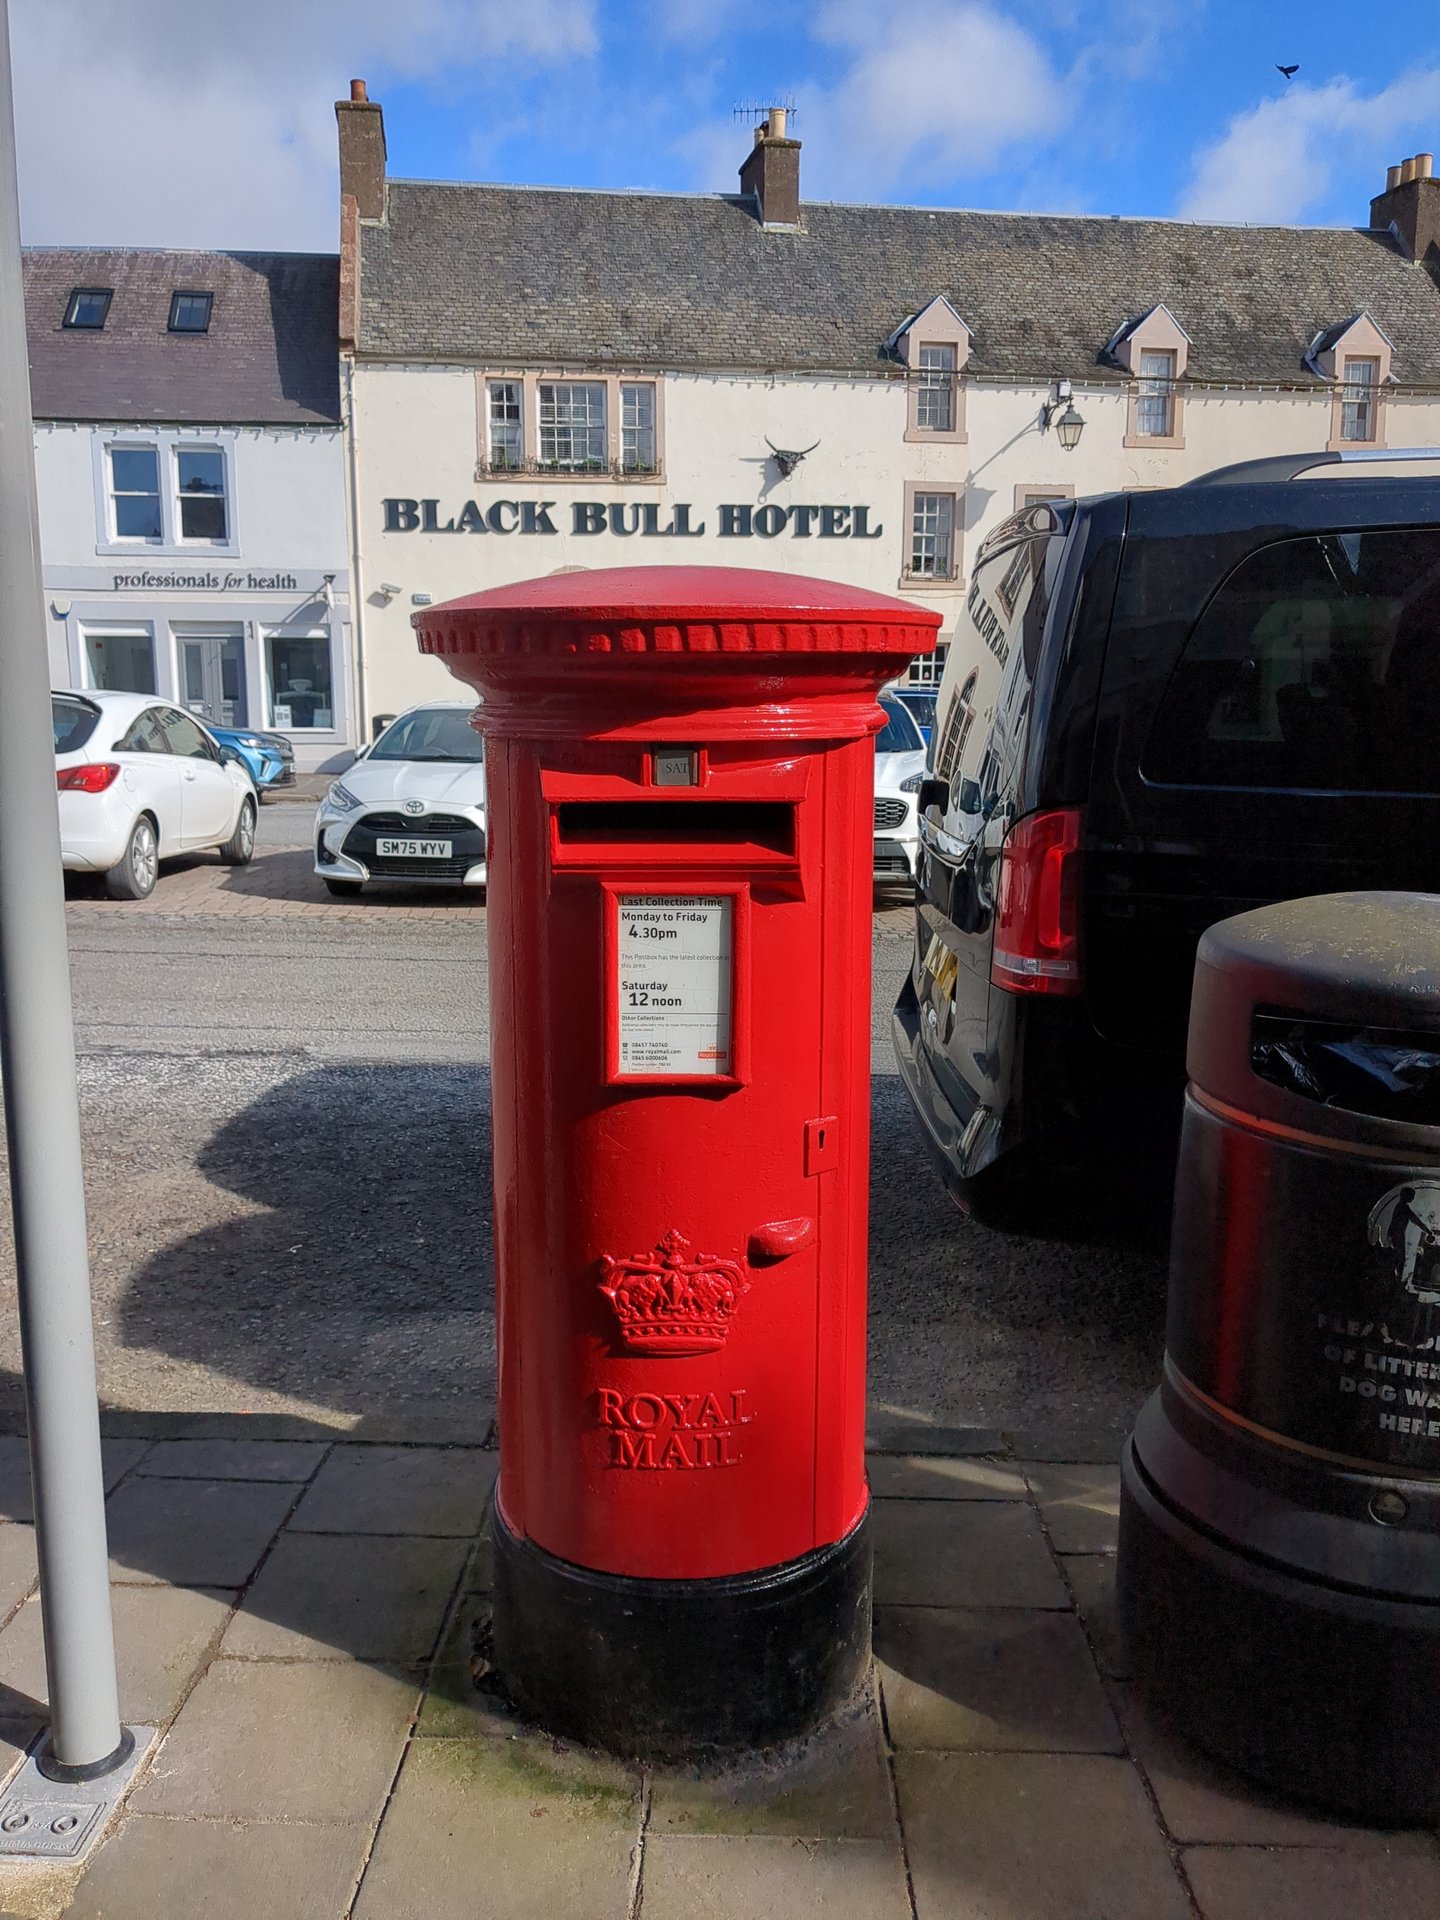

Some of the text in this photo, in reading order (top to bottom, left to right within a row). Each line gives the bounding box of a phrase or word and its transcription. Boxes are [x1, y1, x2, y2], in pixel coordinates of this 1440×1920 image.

[381, 498, 884, 539] BLACK BULL HOTEL
[113, 571, 297, 592] professionals for health
[665, 762, 688, 774] SAT
[382, 841, 446, 856] SM75 WYV
[621, 897, 723, 907] Last Collection Time
[621, 912, 708, 924] Monday to Friday
[628, 924, 678, 941] 4.30pm
[696, 953, 723, 961] collection
[621, 980, 668, 992] Saturday
[628, 992, 682, 1007] 12 noon
[1323, 1344, 1440, 1381] OF LITTER
[1339, 1375, 1397, 1402] DOG
[597, 1387, 757, 1429] ROYAL
[1378, 1412, 1440, 1438] HERE
[610, 1430, 743, 1468] MAIL
